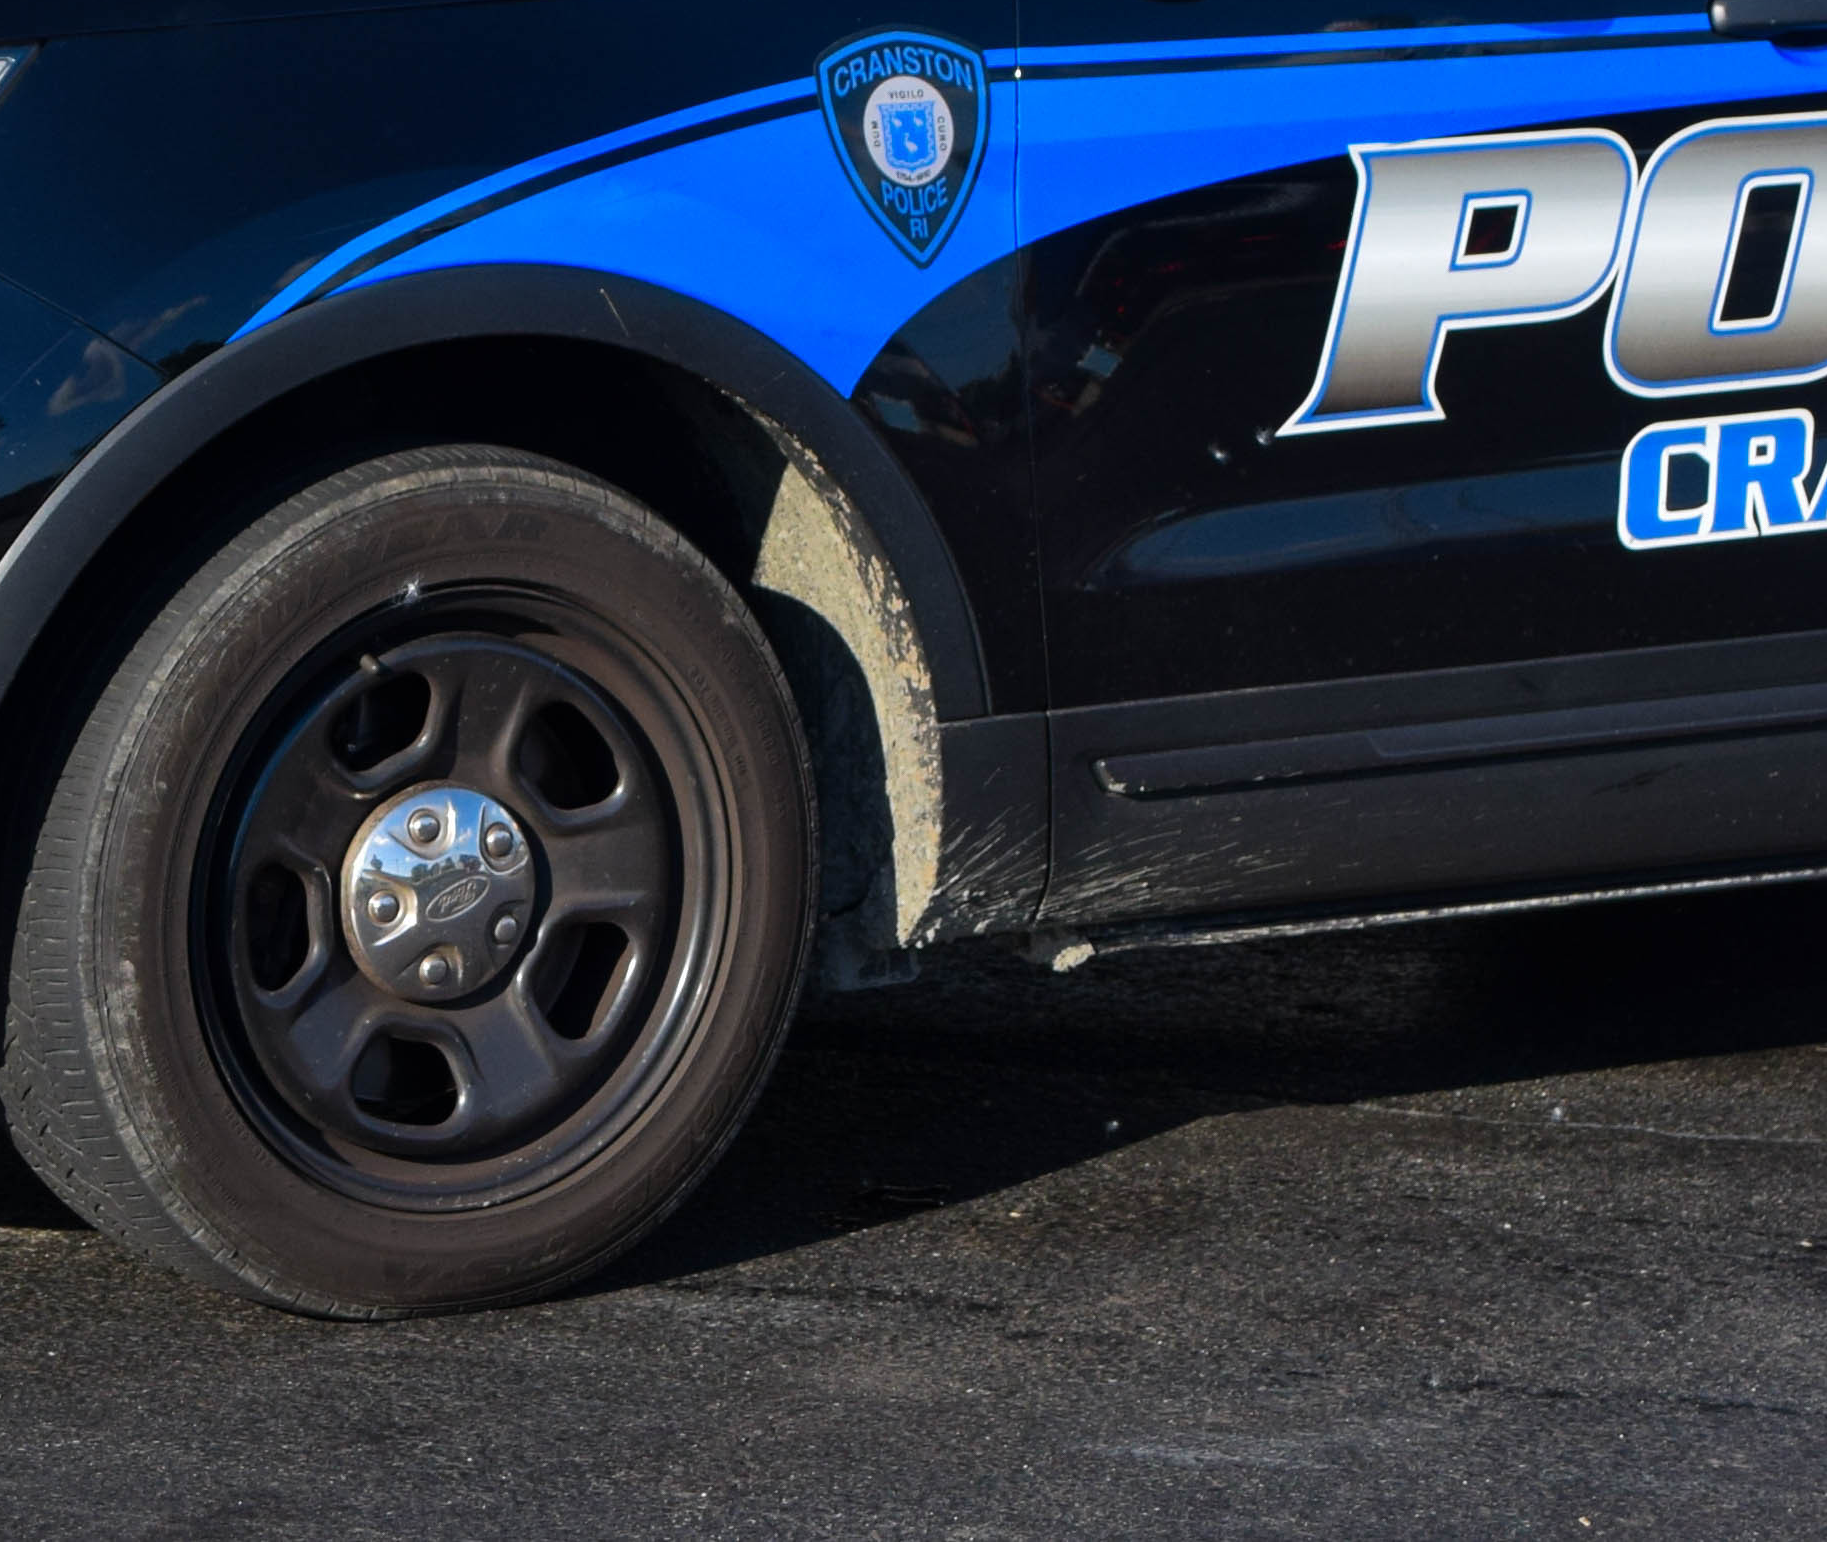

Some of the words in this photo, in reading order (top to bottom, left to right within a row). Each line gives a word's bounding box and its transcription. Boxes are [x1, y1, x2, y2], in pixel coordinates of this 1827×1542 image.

[833, 46, 974, 98] CRANSTON
[888, 89, 924, 99] VIGILO
[880, 177, 949, 217] POLICE
[910, 217, 929, 239] RI
